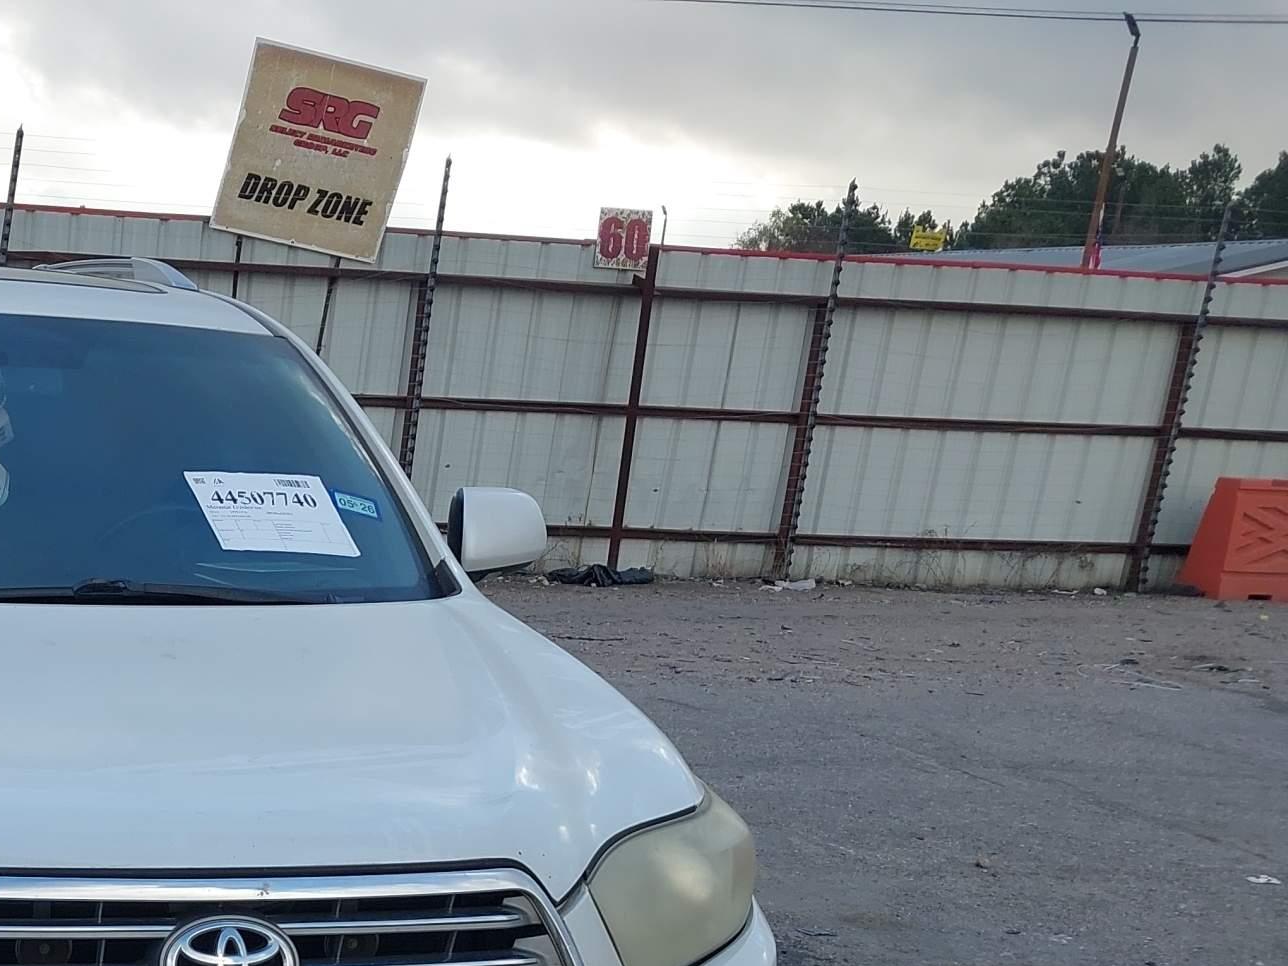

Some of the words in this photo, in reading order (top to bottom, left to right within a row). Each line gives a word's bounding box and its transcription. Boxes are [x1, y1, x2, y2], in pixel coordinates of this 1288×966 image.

[279, 87, 380, 139] SRG
[237, 172, 310, 210] DROP
[306, 188, 373, 226] ZONE
[599, 216, 649, 261] 60
[210, 490, 317, 508] 44507740
